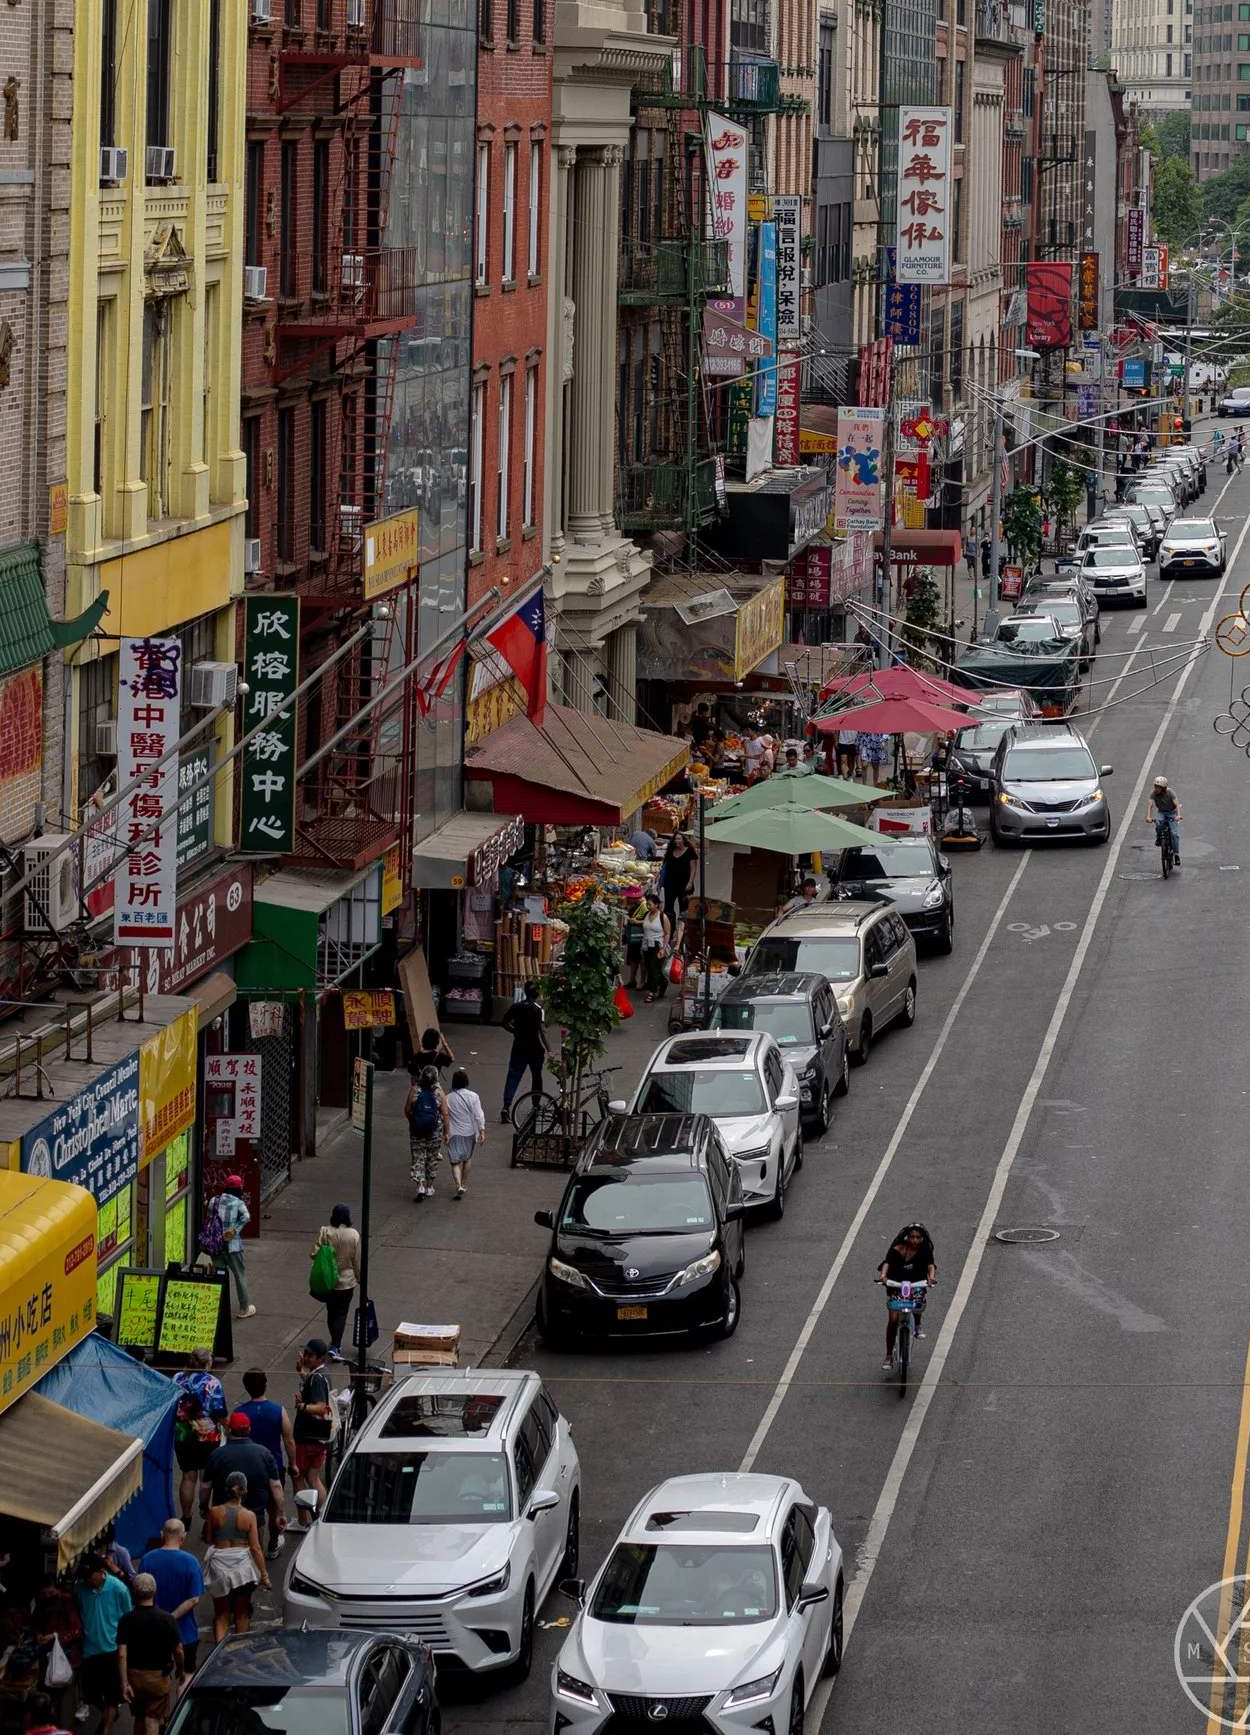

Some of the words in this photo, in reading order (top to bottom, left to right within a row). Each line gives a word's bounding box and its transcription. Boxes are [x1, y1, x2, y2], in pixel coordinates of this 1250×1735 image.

[900, 117, 947, 249] 福華傢俬
[1029, 334, 1052, 342] Library
[839, 489, 876, 497] Communities
[847, 498, 869, 506] Coming
[845, 506, 872, 514] Together
[847, 518, 866, 526] Cathay
[889, 549, 918, 560] Bank
[248, 610, 291, 840] 欣榕服務中心
[127, 640, 168, 907] 香港中醫骨傷科診所
[453, 877, 462, 885] 59
[121, 911, 169, 924] 東百老匯
[207, 1059, 259, 1077] 順駕校
[53, 1117, 67, 1136] New
[67, 1099, 82, 1123] York
[82, 1092, 96, 1113] City
[95, 1076, 117, 1100] Council
[117, 1058, 138, 1085] Member
[238, 1082, 258, 1136] 永順駕校
[54, 1108, 110, 1171] Christopher
[110, 1087, 138, 1126] Marte
